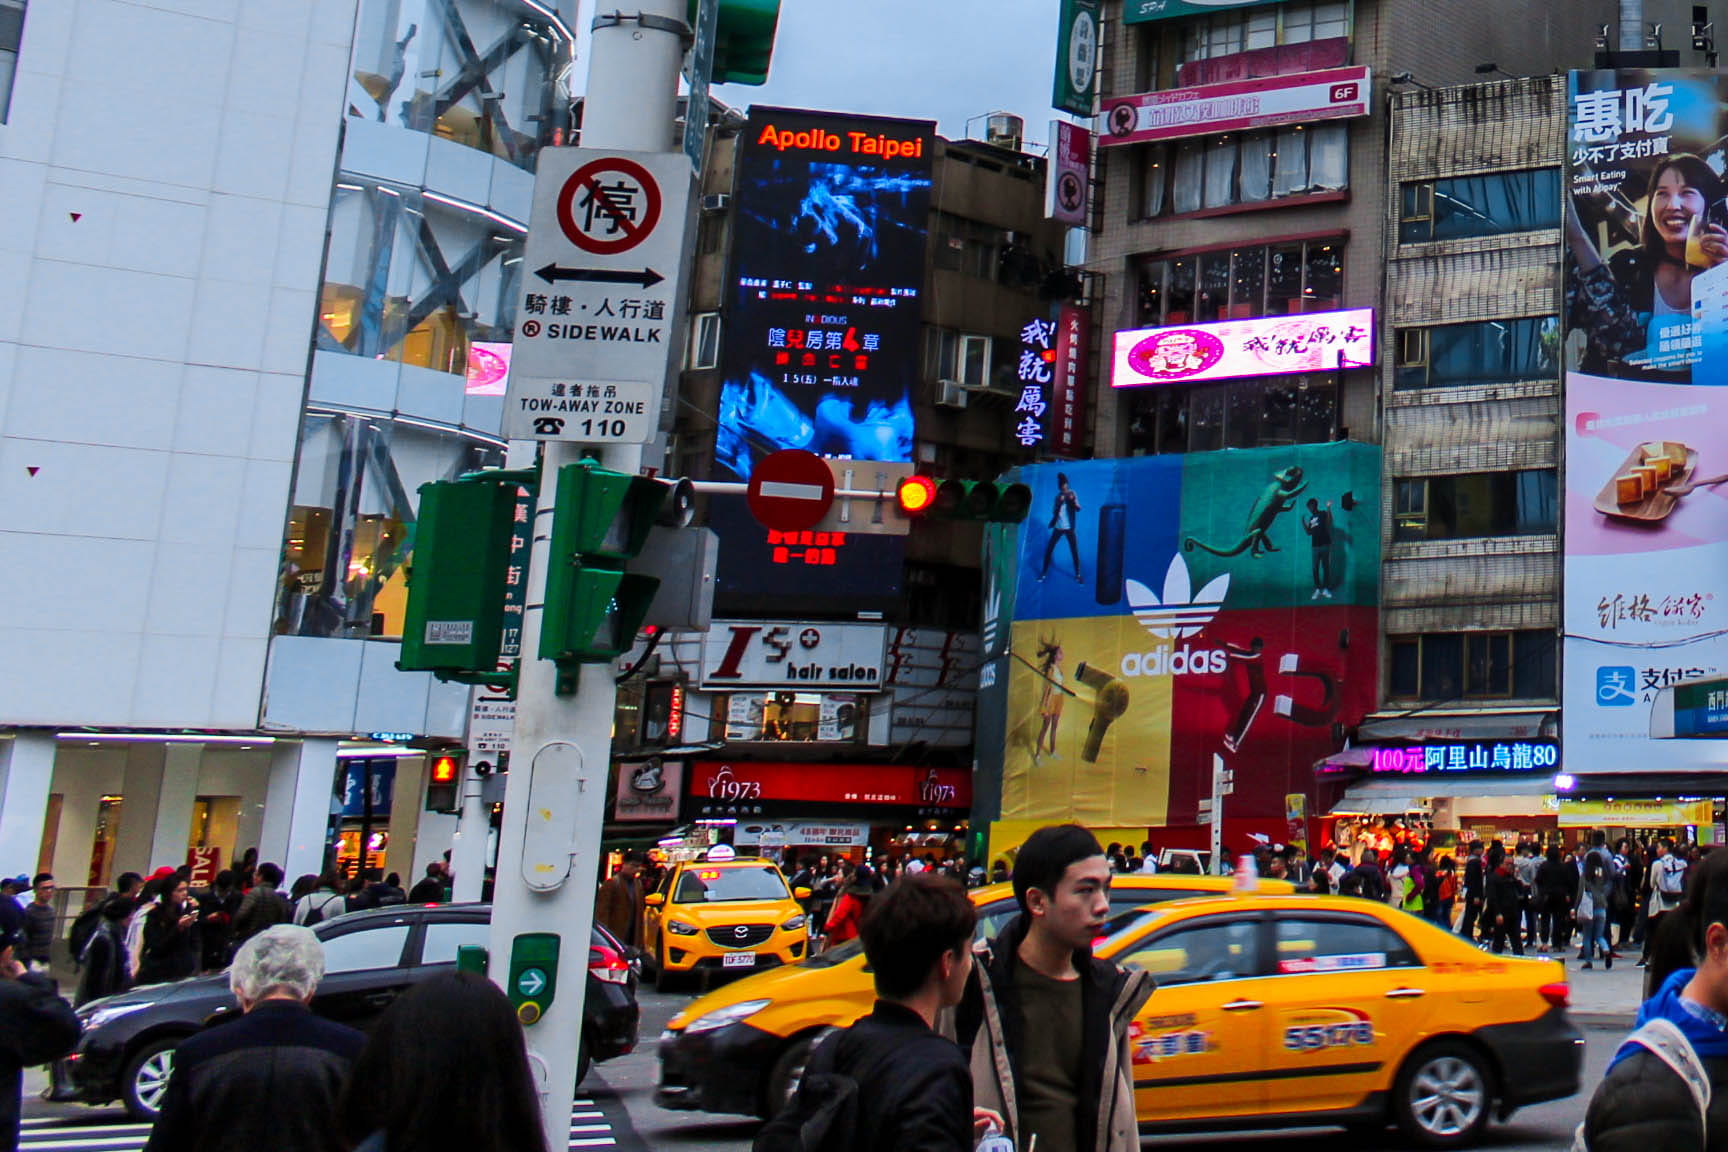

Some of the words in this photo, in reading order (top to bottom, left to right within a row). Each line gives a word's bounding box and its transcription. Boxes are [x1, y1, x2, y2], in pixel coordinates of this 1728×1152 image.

[1334, 85, 1355, 100] 6F
[1574, 82, 1674, 143] 惠吃
[758, 124, 841, 152] Apollo
[847, 131, 923, 161] Taipei
[1573, 174, 1599, 184] Smart
[1600, 169, 1626, 181] Eating
[1573, 184, 1592, 195] with
[580, 180, 639, 235] 停
[547, 323, 662, 344] SIDEWALK
[520, 397, 600, 414] TOW-AWAY
[604, 400, 644, 416] ZONE
[580, 419, 626, 437] 110
[1121, 645, 1227, 677] adidas
[787, 662, 824, 681] hair
[829, 664, 877, 682] salon
[1641, 667, 1705, 691] 支付
